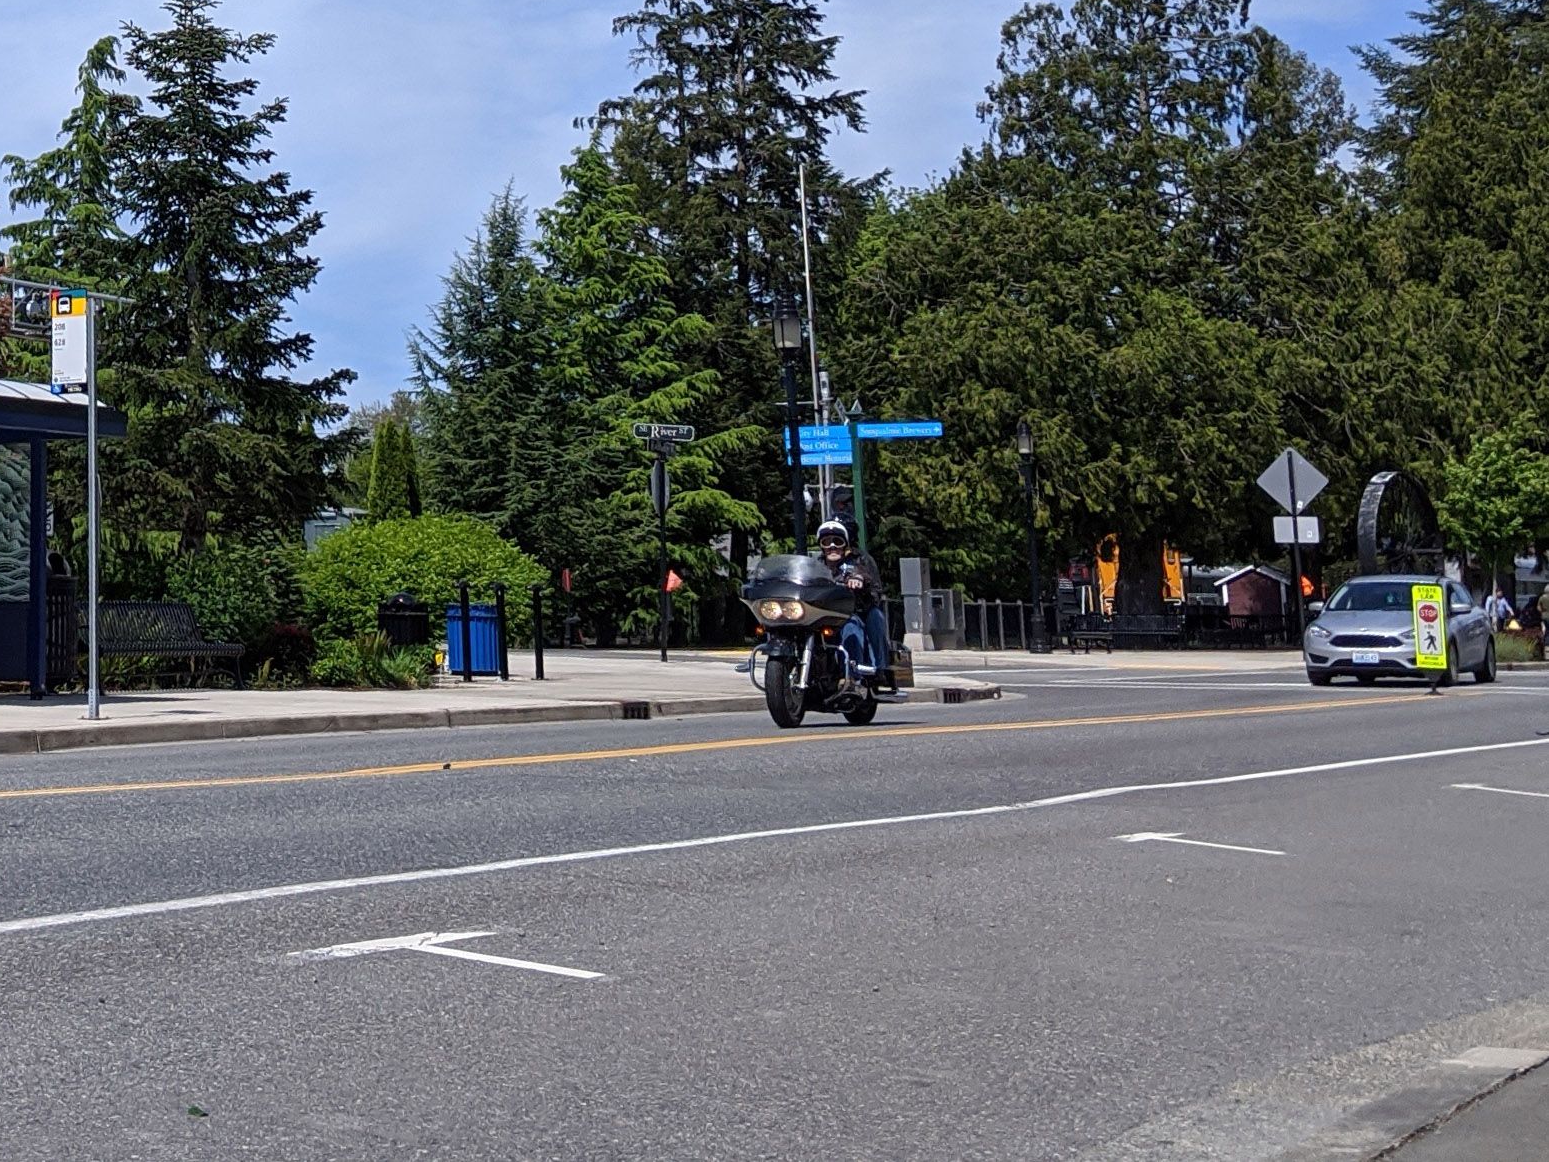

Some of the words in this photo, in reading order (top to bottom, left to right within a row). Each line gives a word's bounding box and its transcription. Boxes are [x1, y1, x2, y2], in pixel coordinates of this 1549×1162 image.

[651, 425, 677, 438] River
[813, 429, 829, 437] Hall
[814, 441, 839, 450] Office
[1419, 609, 1437, 617] STOP
